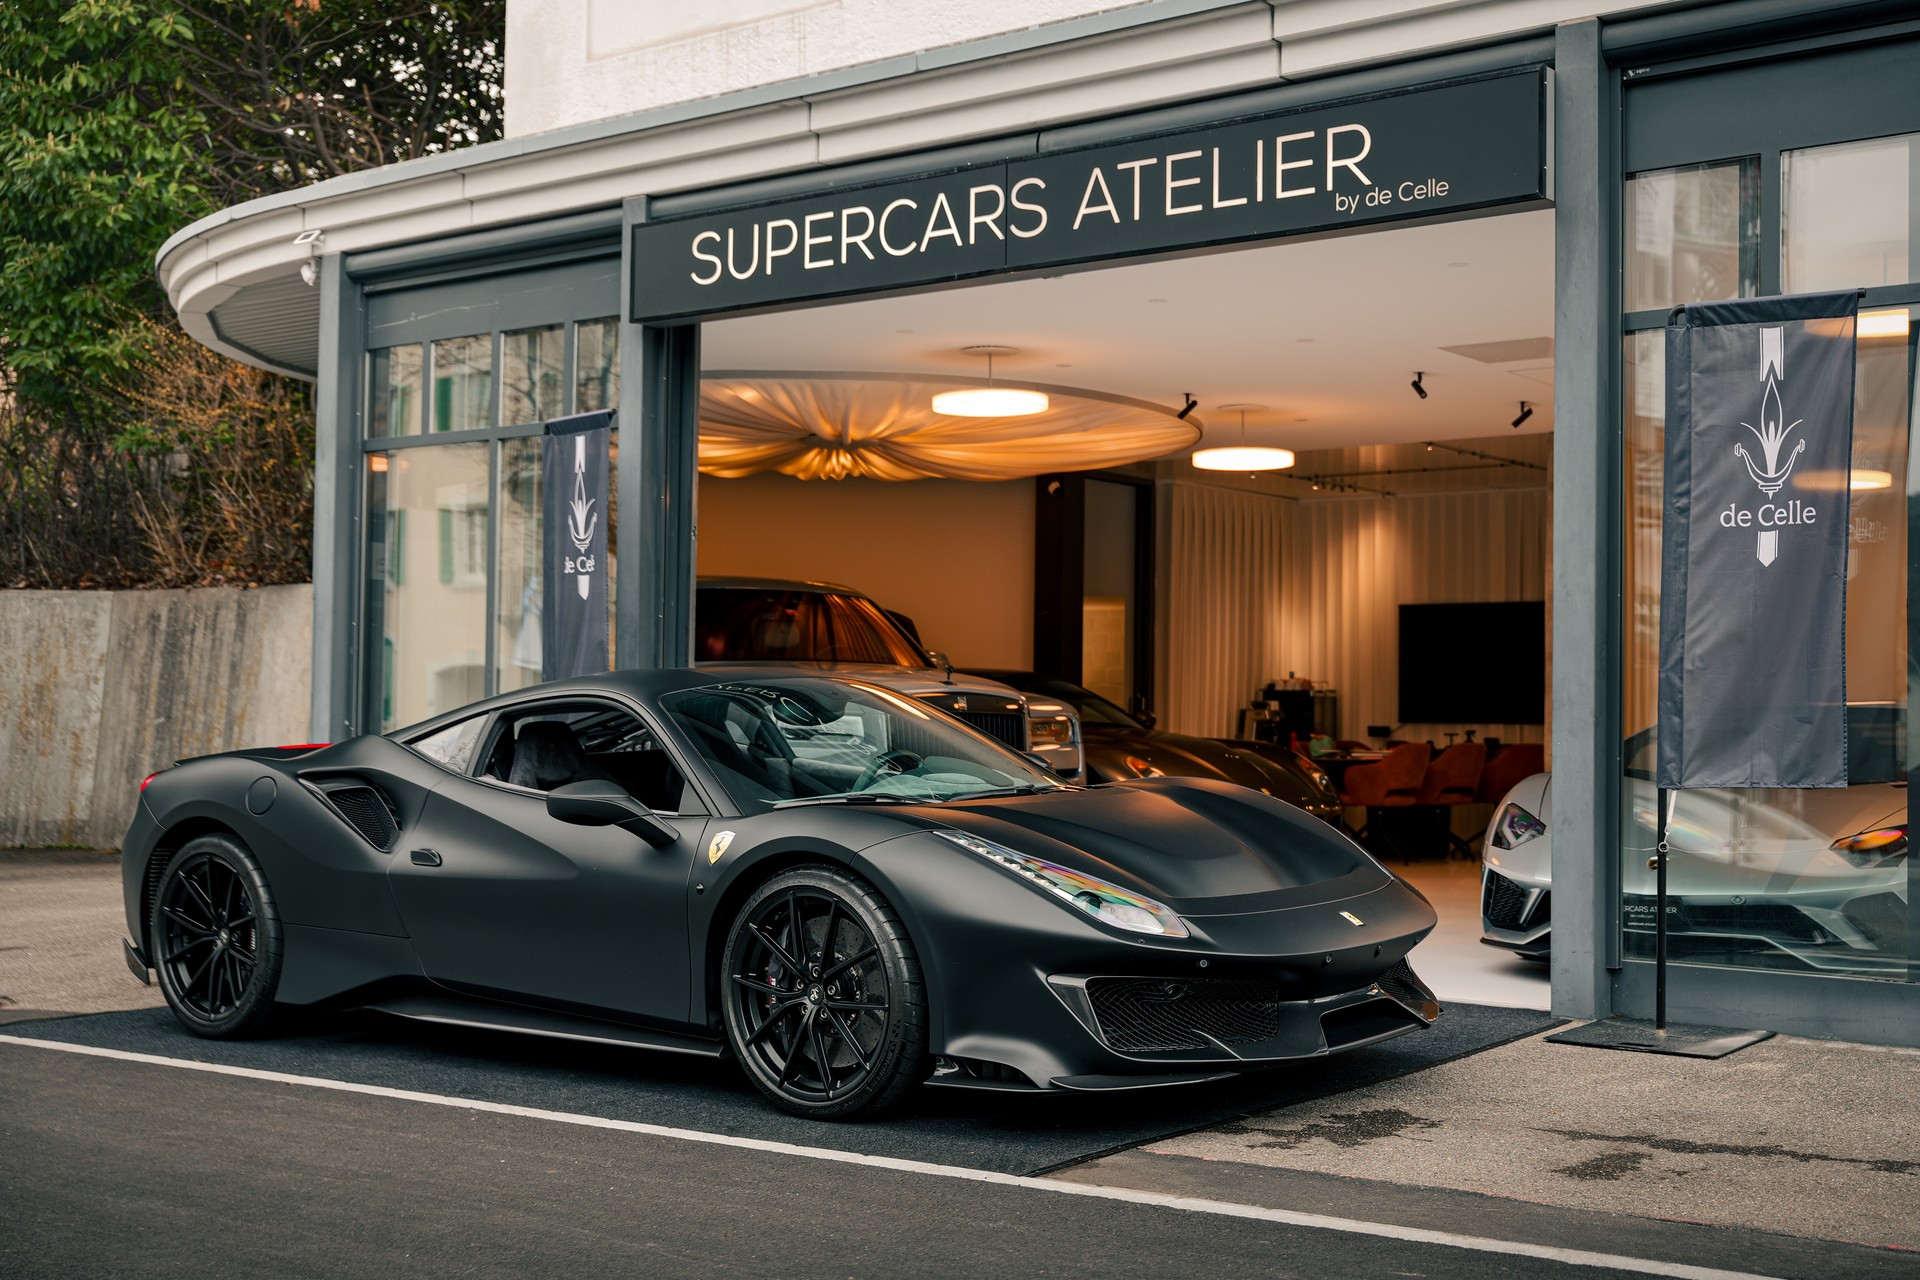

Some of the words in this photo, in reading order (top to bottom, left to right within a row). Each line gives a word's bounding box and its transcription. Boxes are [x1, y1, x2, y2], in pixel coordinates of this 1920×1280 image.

[690, 177, 1048, 286] SUPERCARS
[1072, 124, 1373, 230] ATELIER
[1335, 192, 1360, 215] by
[1365, 186, 1393, 207] de
[1398, 178, 1449, 202] Celle
[1720, 503, 1752, 527] de
[1758, 500, 1817, 526] Celle
